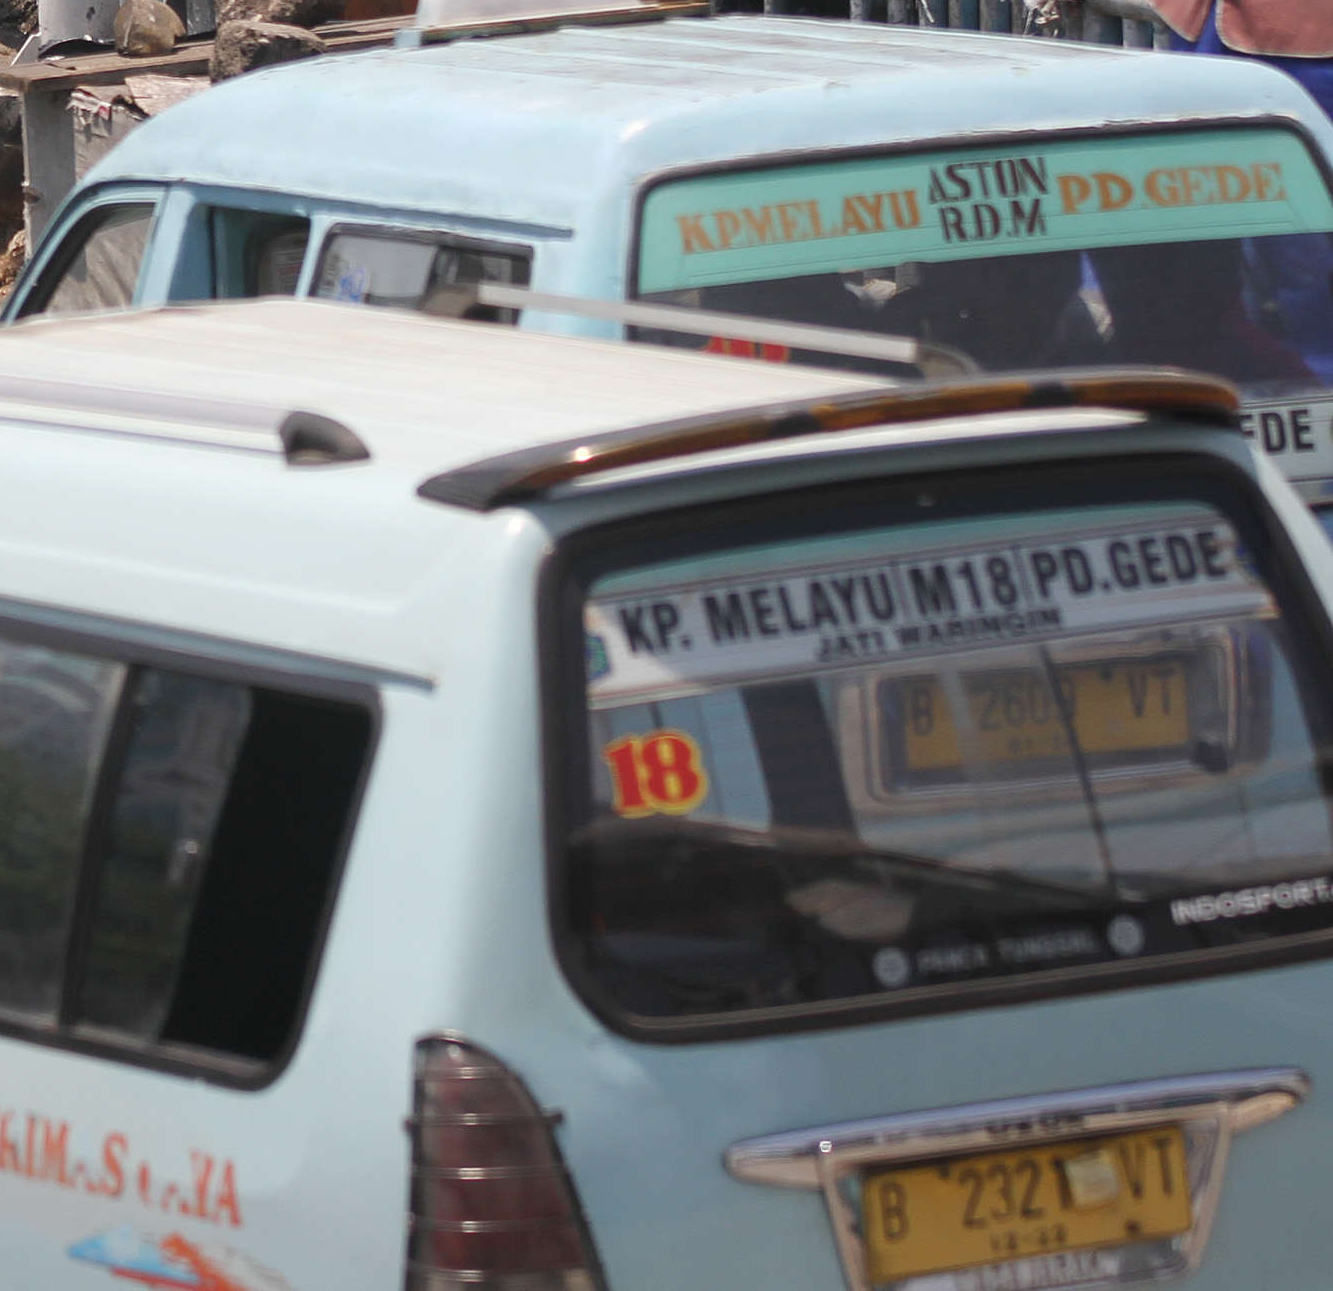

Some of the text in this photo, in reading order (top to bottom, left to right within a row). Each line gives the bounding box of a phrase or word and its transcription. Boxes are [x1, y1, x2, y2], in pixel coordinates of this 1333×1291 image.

[618, 531, 1226, 658] KP. MELAYU M18 PD.GEDE
[813, 608, 1064, 664] JATI WARINGIN
[604, 727, 710, 820] 18
[878, 1180, 910, 1243] B
[1119, 1134, 1173, 1200] VT
